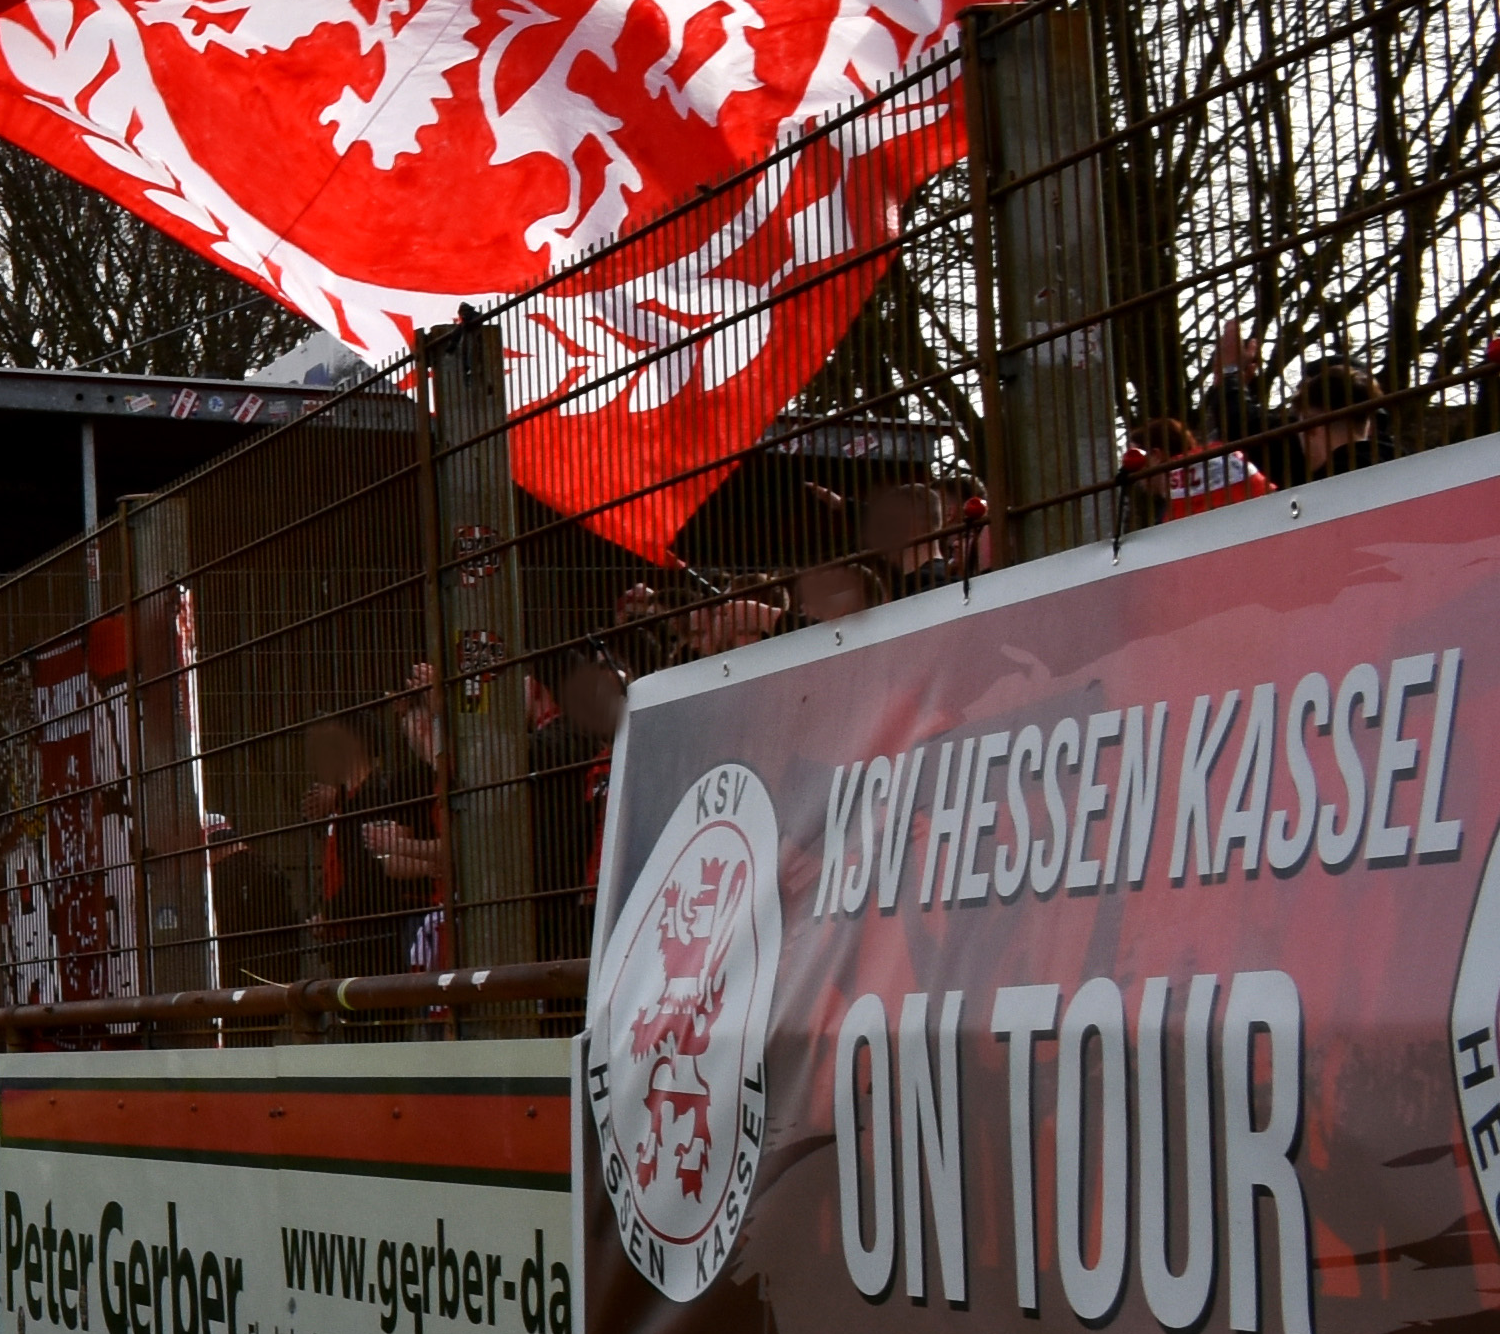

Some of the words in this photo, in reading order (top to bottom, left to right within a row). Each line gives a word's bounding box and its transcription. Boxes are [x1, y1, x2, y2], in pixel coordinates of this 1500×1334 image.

[696, 771, 748, 825] KSV
[813, 748, 925, 919] KSV
[919, 701, 1168, 905] HESSEN
[1168, 648, 1464, 880] KASSEL
[589, 1062, 665, 1287] HESSEN
[695, 1061, 764, 1289] KASSEL
[834, 990, 968, 1307] ON
[1457, 1025, 1500, 1232] HE
[4, 1190, 94, 1333] Peter
